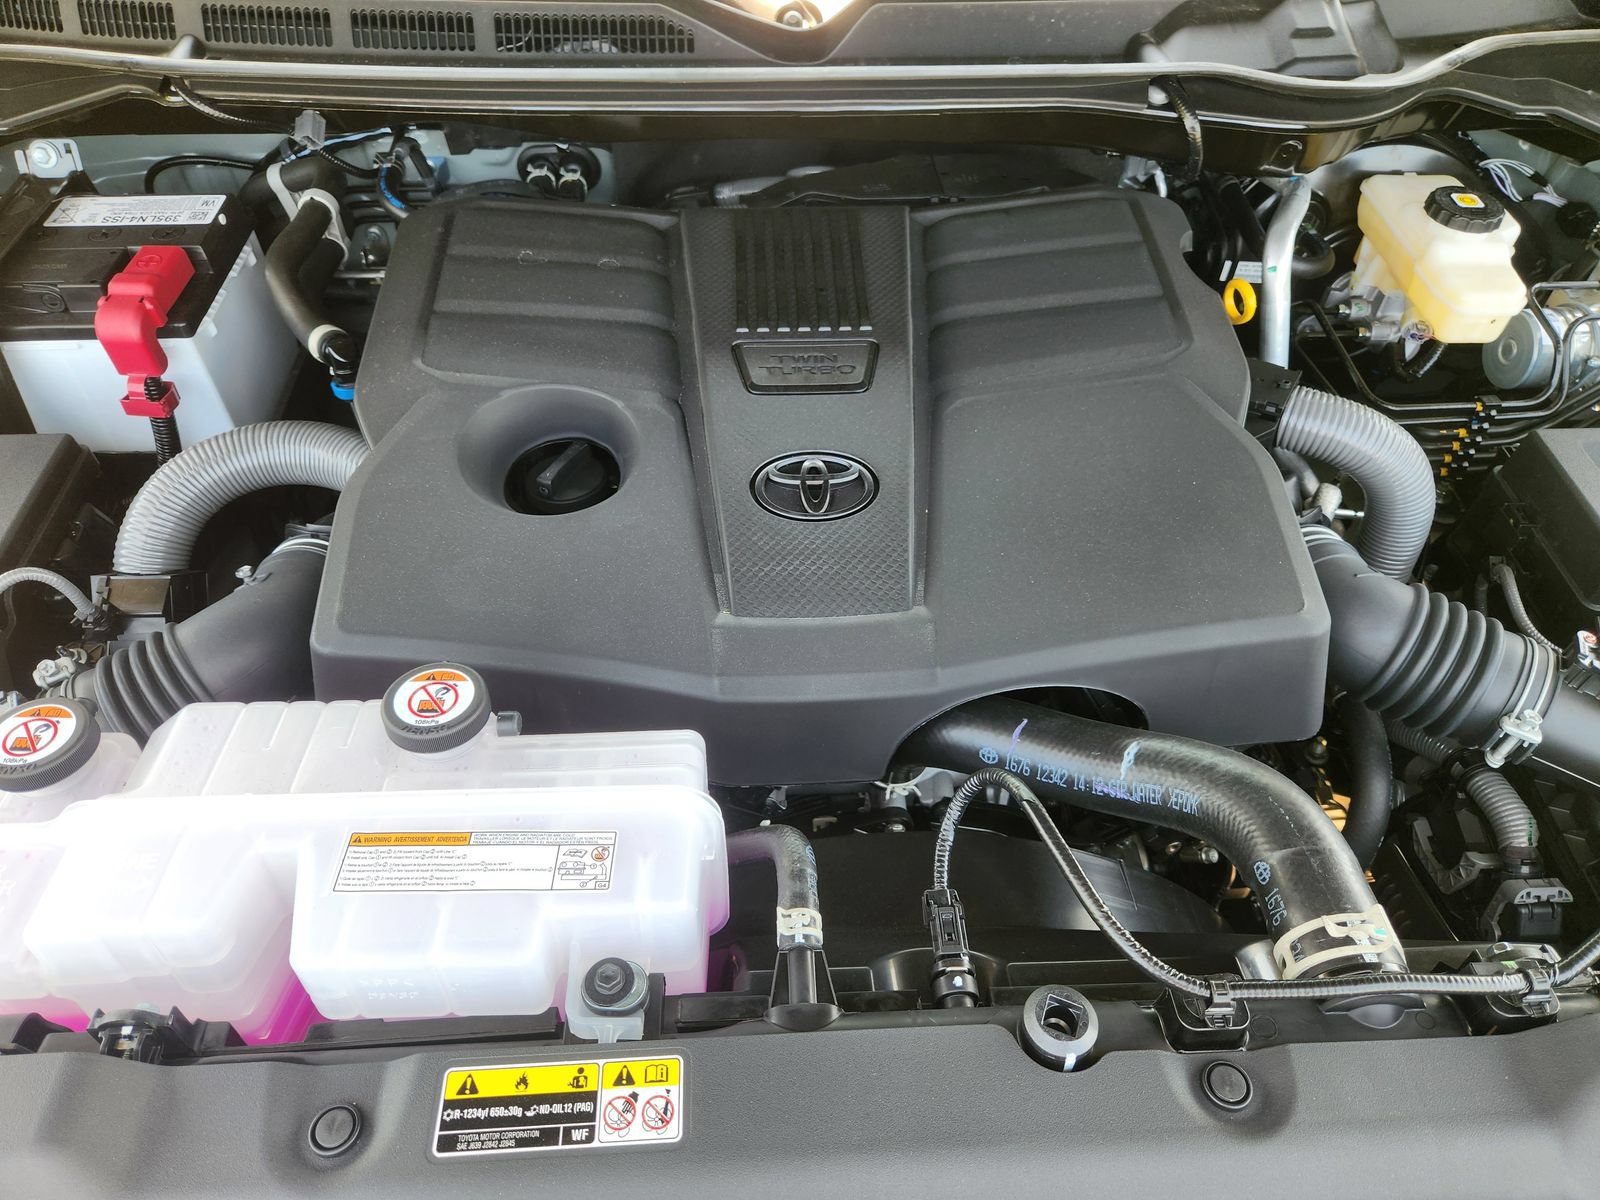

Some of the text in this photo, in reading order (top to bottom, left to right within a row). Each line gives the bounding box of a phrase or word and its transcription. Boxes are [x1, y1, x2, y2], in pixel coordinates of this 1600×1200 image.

[201, 199, 216, 207] VM
[100, 214, 182, 224] 395LN4-ISS
[769, 353, 839, 364] TWIN
[758, 364, 857, 375] TURBO
[1005, 752, 1031, 777] 1676
[1036, 763, 1068, 788] 12342
[1132, 782, 1162, 806] WATER
[1264, 888, 1288, 926] 1676
[454, 1107, 489, 1120] R-1234yf
[490, 1105, 523, 1118] 650±30g
[573, 1101, 594, 1114] (PAG)
[458, 1130, 540, 1143] TOYOTA MOTOR CORPORATION
[571, 1128, 590, 1142] WF
[456, 1142, 468, 1151] SAE
[468, 1141, 482, 1150] J639
[482, 1140, 499, 1149] J2842
